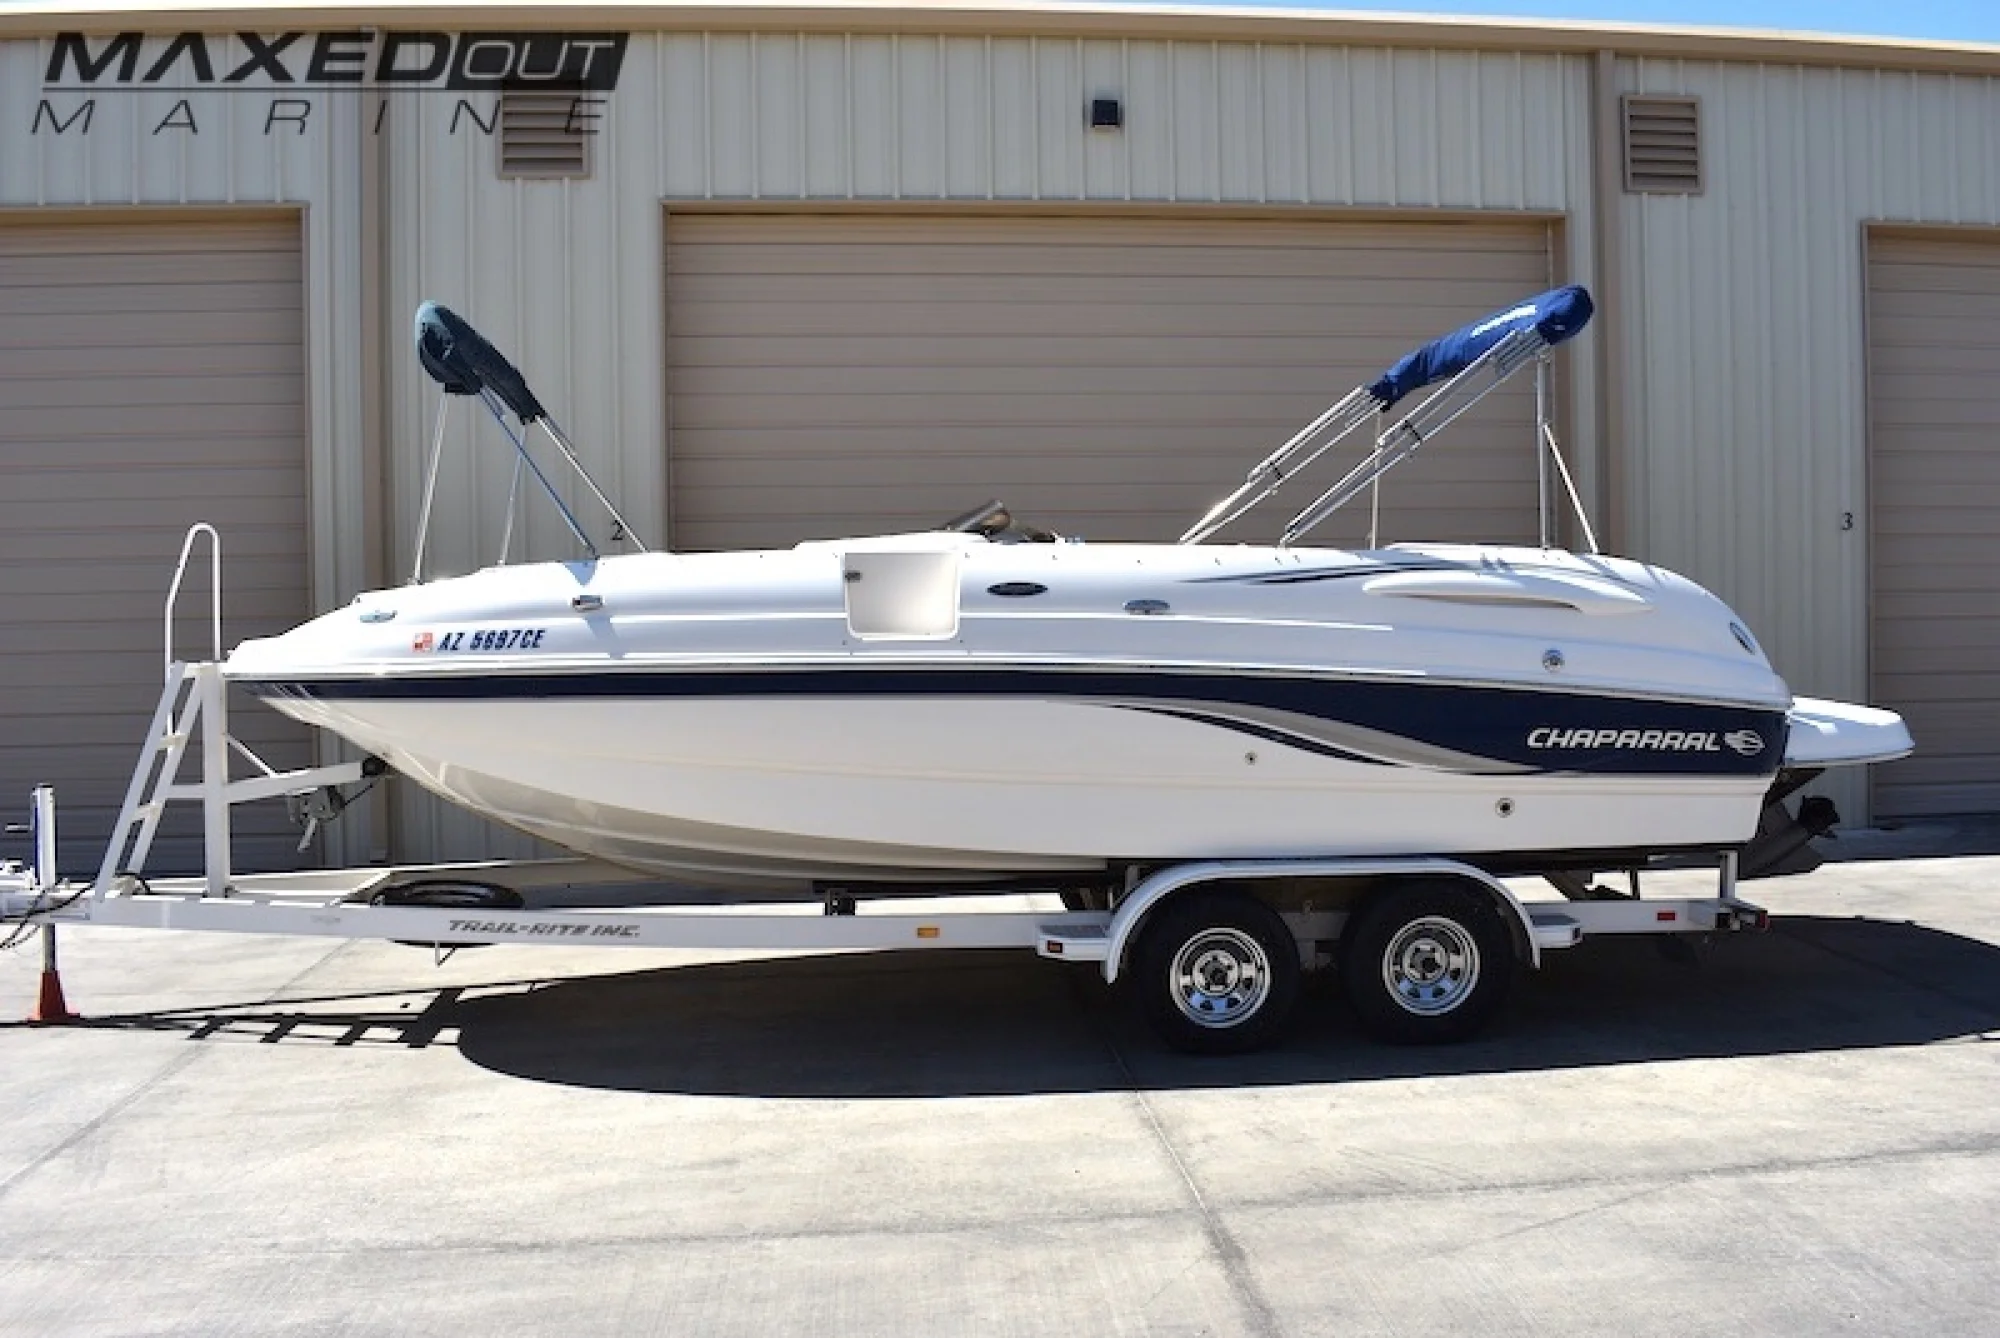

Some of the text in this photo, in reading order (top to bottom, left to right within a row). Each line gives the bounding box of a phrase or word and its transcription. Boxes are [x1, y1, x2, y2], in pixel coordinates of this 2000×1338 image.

[611, 519, 624, 541] 2
[1841, 512, 1853, 531] 3
[437, 632, 466, 651] AZ
[1527, 727, 1721, 751] CHAPARRAL
